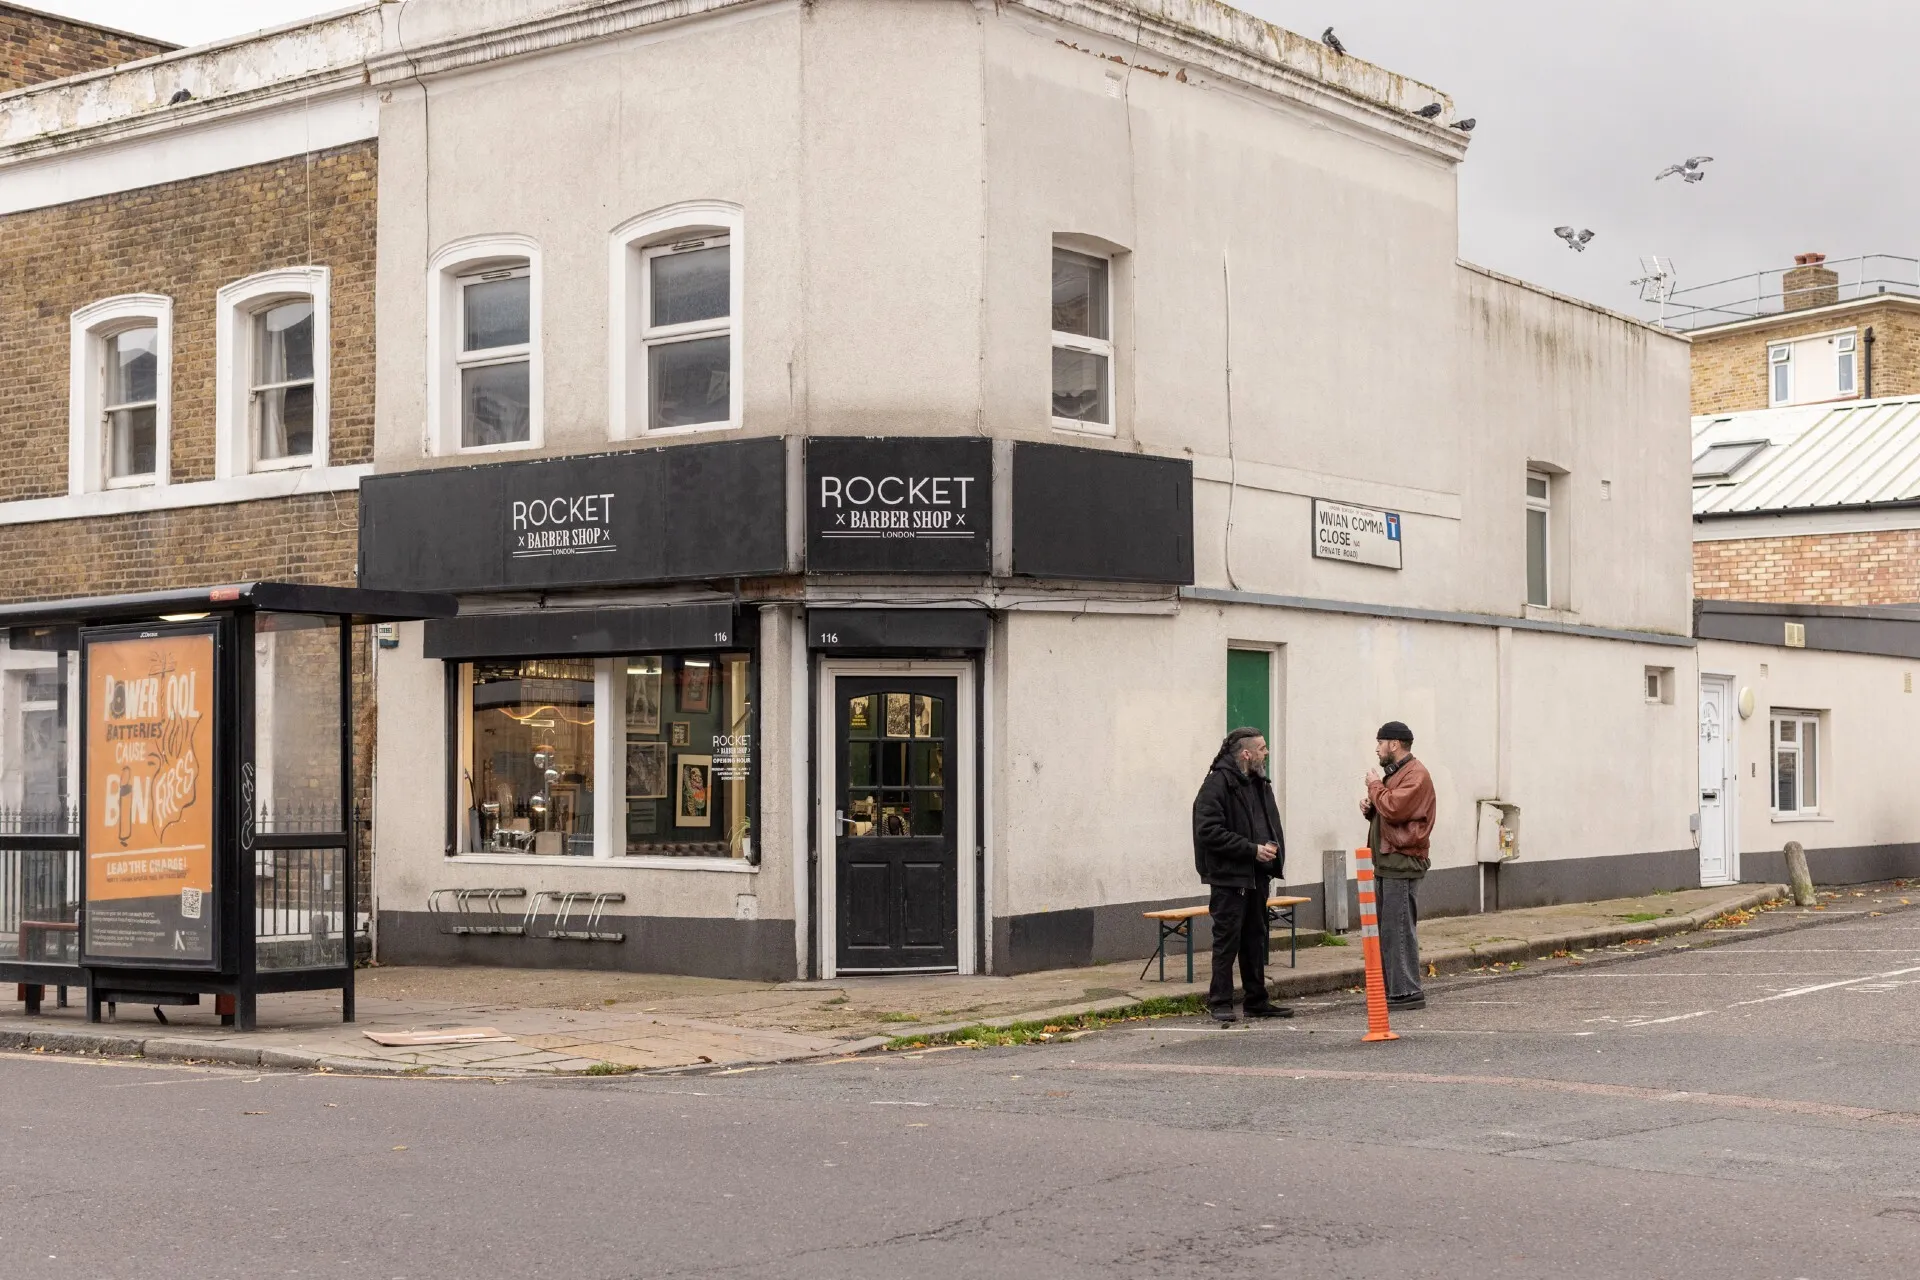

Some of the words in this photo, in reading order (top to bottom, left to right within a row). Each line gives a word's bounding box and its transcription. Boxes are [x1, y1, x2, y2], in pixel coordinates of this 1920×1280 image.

[821, 476, 975, 508] ROCKET
[513, 493, 615, 530] ROCKET
[850, 510, 909, 528] BARBER
[913, 510, 952, 528] SHOP
[1320, 511, 1348, 528] VIVIAN
[1352, 517, 1384, 535] COMMA
[527, 530, 570, 549] BARBER
[572, 527, 600, 546] SHOP
[882, 531, 915, 539] LONDON
[1320, 529, 1351, 546] CLOSE
[552, 548, 576, 556] LONDON
[714, 632, 727, 642] 116
[821, 633, 838, 643] 116
[106, 722, 162, 742] BATTERIES
[115, 741, 146, 764] CAUSE
[155, 749, 194, 828] FIRES
[106, 861, 129, 876] LEAD
[129, 859, 147, 874] THE
